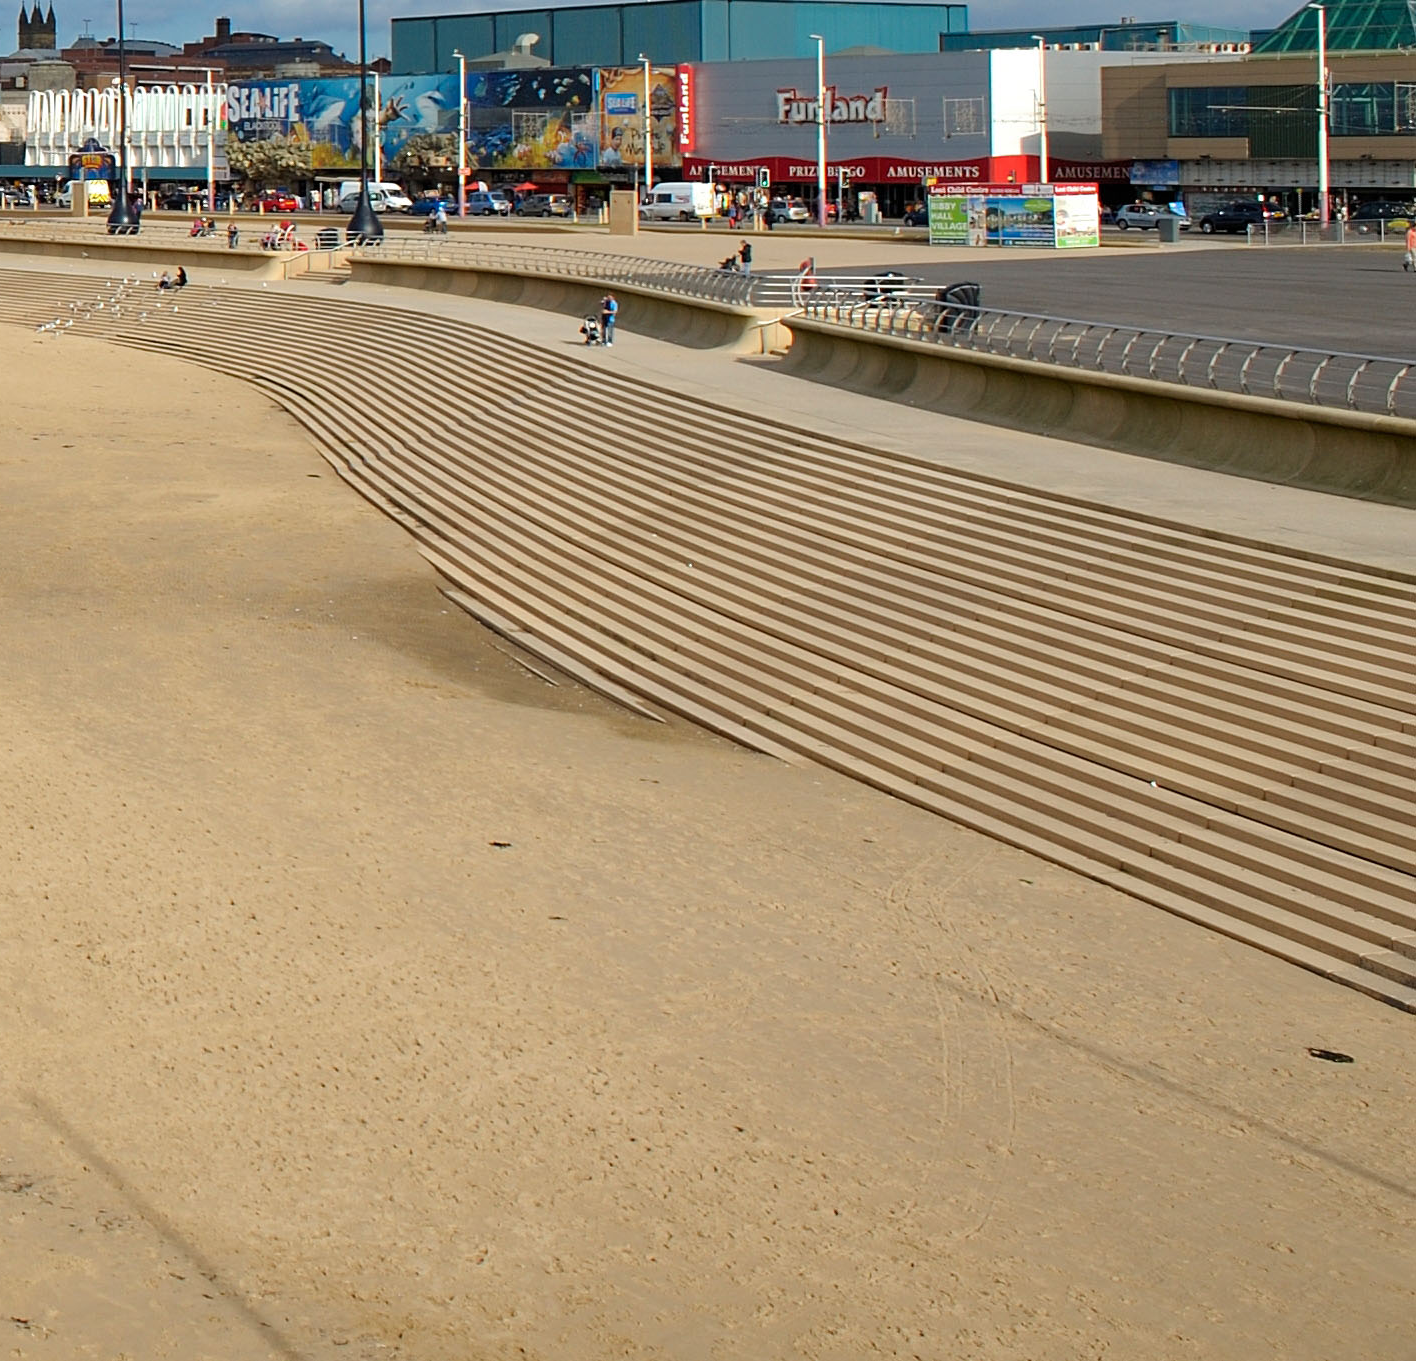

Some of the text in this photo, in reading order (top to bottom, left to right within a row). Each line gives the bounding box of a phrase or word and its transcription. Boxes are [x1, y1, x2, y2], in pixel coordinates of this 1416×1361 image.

[228, 85, 261, 122] SEA
[680, 73, 689, 145] Funland
[776, 86, 888, 125] Funland
[689, 165, 769, 176] AMSEMENT
[789, 165, 824, 177] PRIZ
[887, 166, 980, 178] AMUSEMENTS
[1055, 166, 1131, 178] AMUSEMEN
[931, 222, 968, 231] VILLAGE
